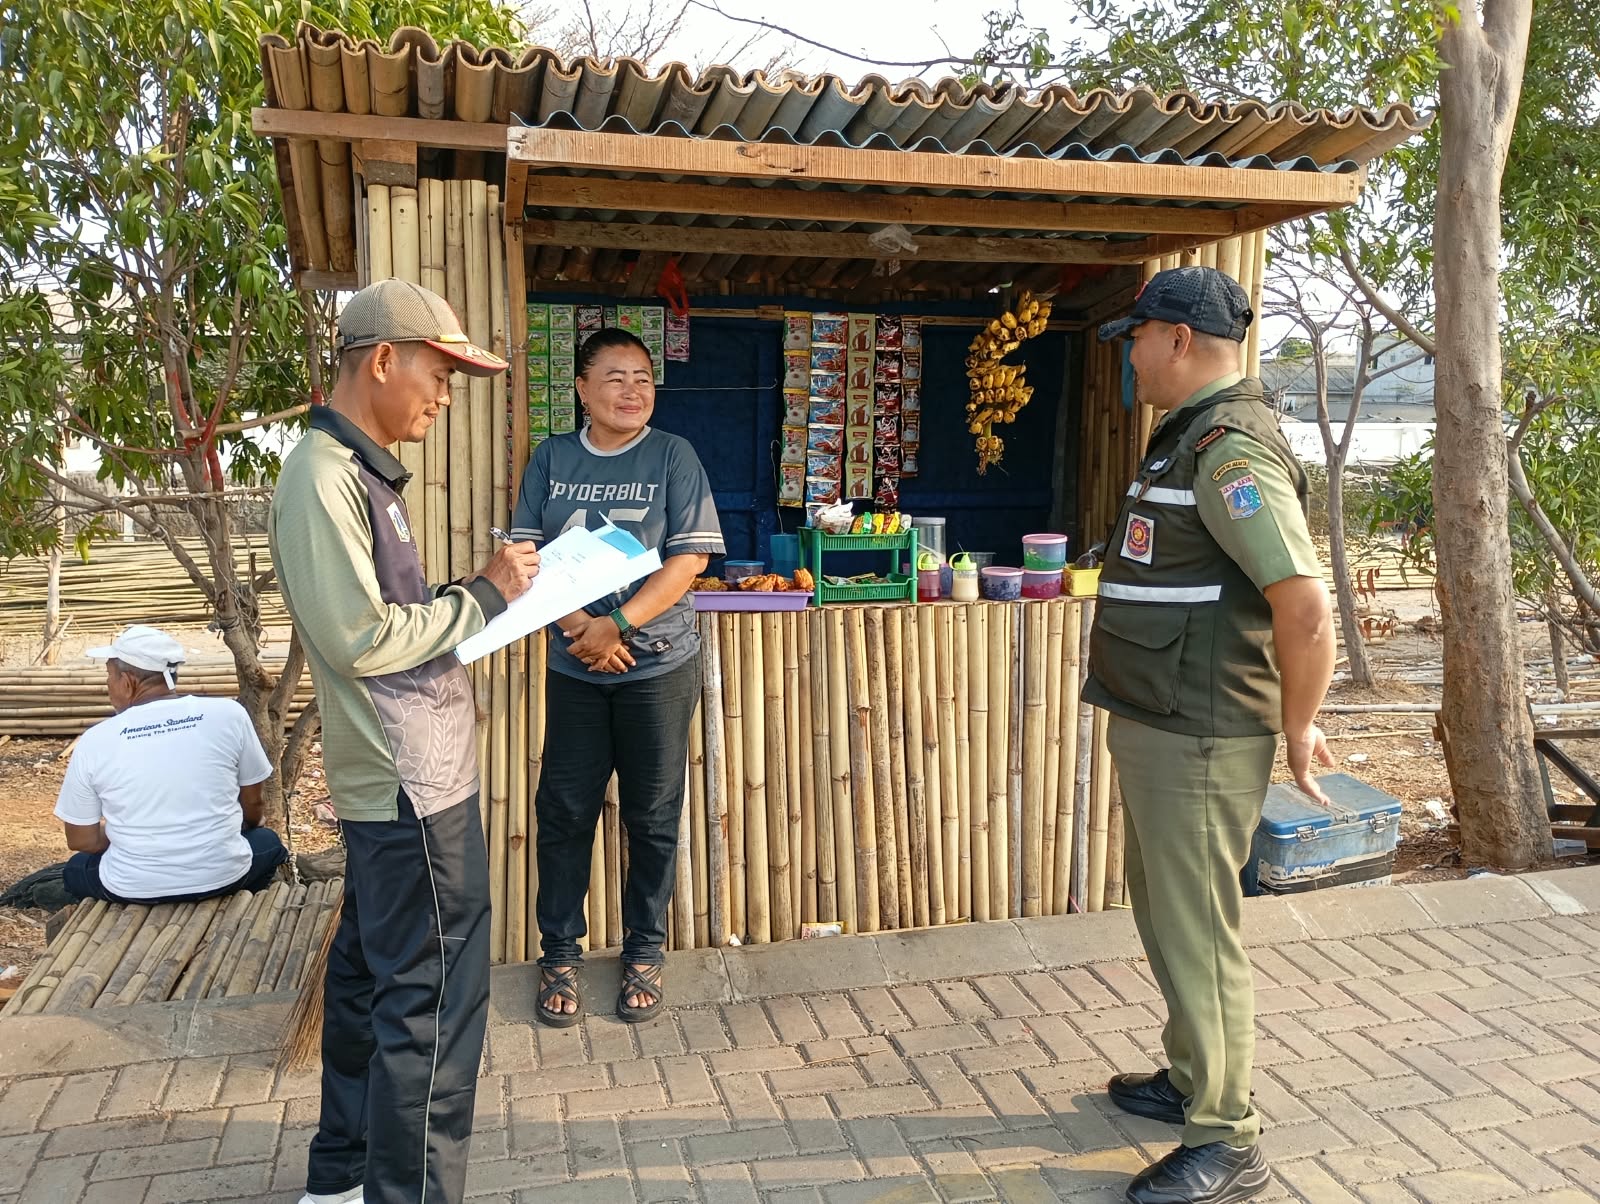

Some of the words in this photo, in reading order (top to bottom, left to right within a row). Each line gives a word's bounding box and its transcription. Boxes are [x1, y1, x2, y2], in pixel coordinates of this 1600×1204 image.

[119, 723, 162, 736] American
[163, 713, 204, 727] Standard
[167, 723, 197, 732] Standard
